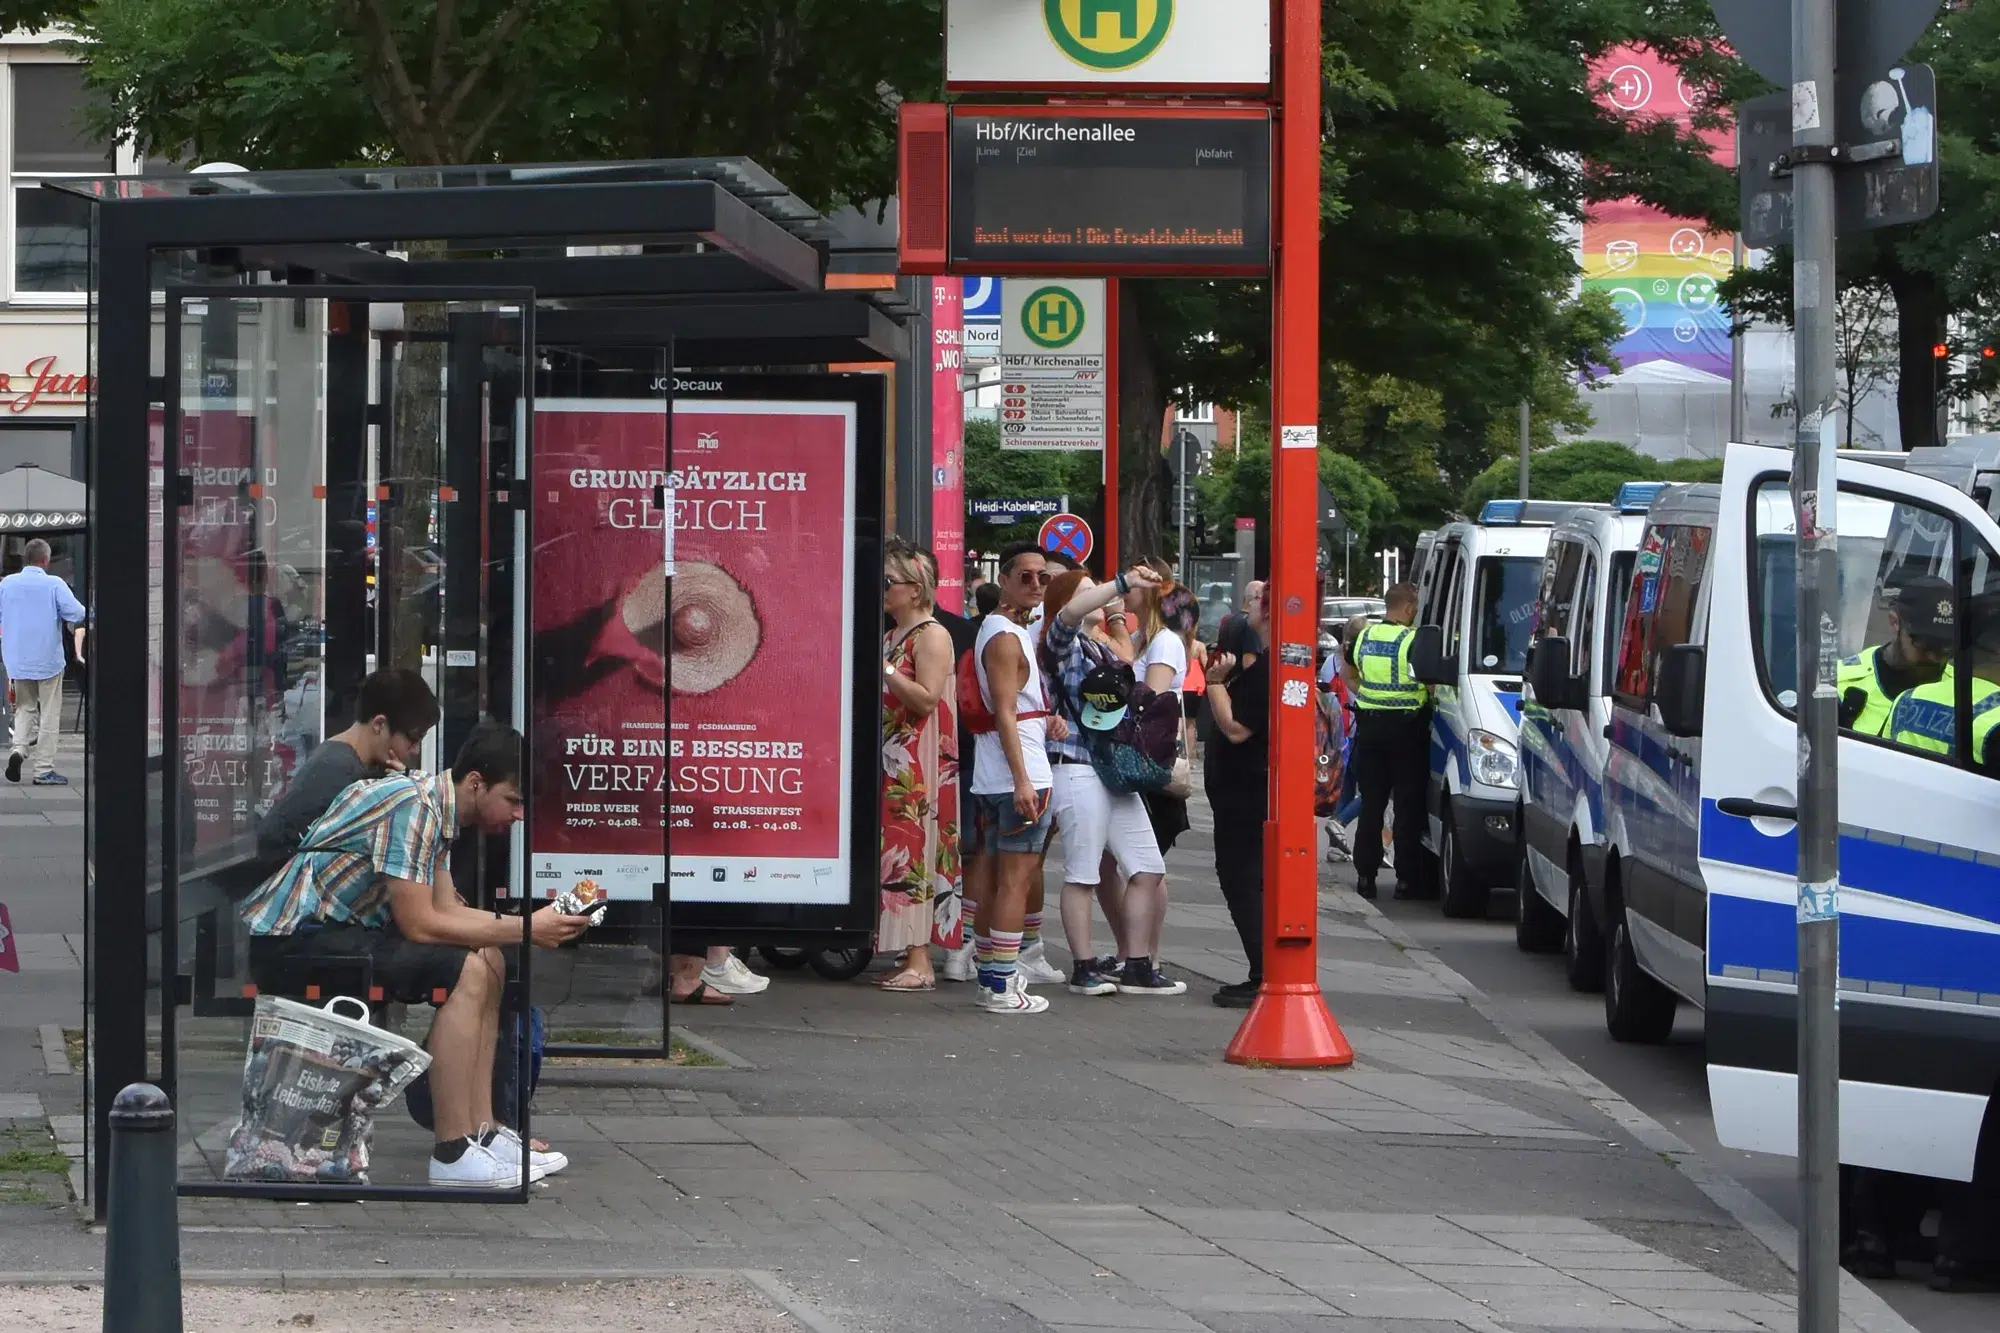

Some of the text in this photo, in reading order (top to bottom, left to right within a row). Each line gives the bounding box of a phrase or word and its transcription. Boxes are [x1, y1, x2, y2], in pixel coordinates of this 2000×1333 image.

[976, 123, 1135, 143] Hbf/Kirchenallee
[978, 146, 1233, 159] Linie Ziel Abfahrt
[967, 325, 999, 341] Nord
[1033, 356, 1100, 367] Kirchenallee
[650, 377, 723, 392] JCDecaux
[1010, 399, 1021, 407] 17
[1007, 424, 1023, 432] 607
[1005, 438, 1099, 447] Schienenersatzverkehr
[569, 465, 807, 491] GRUNDSÄTZLICH
[974, 501, 1058, 513] Heidi-KabelPlatz
[608, 498, 767, 531] GLEICH
[1494, 547, 1511, 555] 42
[621, 722, 757, 732] #HAMBURGRIDE #CSDHAMBURG
[566, 733, 803, 759] FÜR EINE BESSERE
[563, 763, 804, 794] VERFASSUNG
[566, 802, 601, 812] PRIDE
[603, 804, 640, 813] WEEK
[713, 806, 803, 816] STRASSENFEST
[566, 818, 597, 828] 27.07.
[607, 818, 641, 828] 04.08.
[712, 820, 751, 829] 02.08.
[762, 821, 802, 831] 04.08.
[583, 868, 603, 876] Wall
